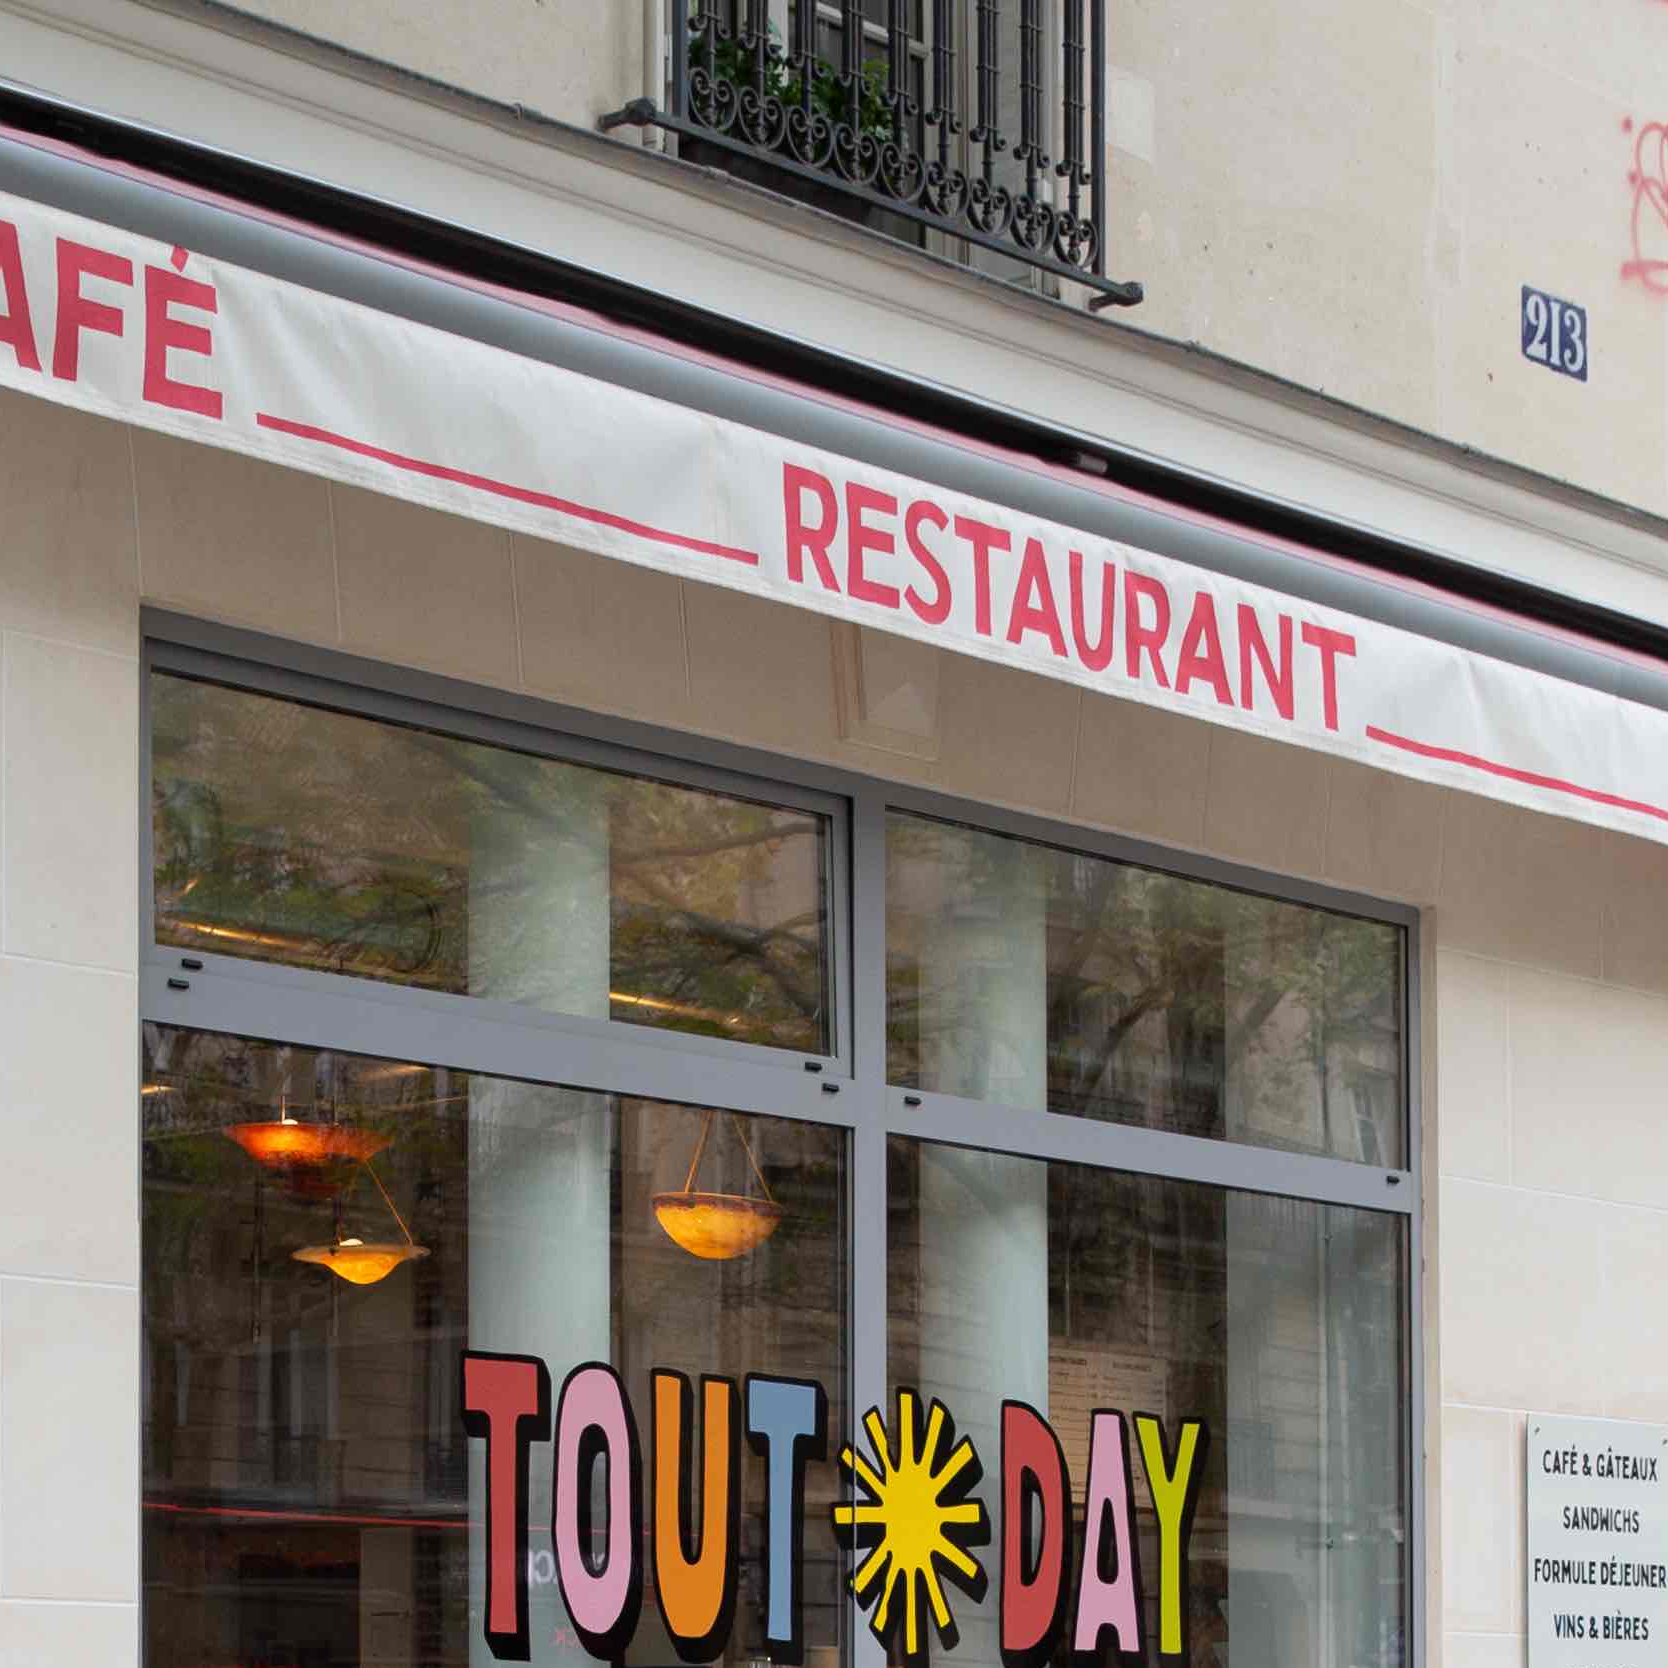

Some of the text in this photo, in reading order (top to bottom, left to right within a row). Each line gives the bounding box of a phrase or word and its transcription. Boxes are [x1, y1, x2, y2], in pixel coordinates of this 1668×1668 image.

[1525, 293, 1585, 373] 213
[781, 462, 1358, 733] RESTAURANT
[1542, 1444, 1658, 1482] CAFÉ & GÂTEAUX
[460, 1349, 828, 1667] TOUT
[1563, 1506, 1641, 1534] SANDWICHS
[1534, 1555, 1668, 1589] FORMULE DÉJEUNER
[1553, 1610, 1650, 1641] VINS & BIÈRES
